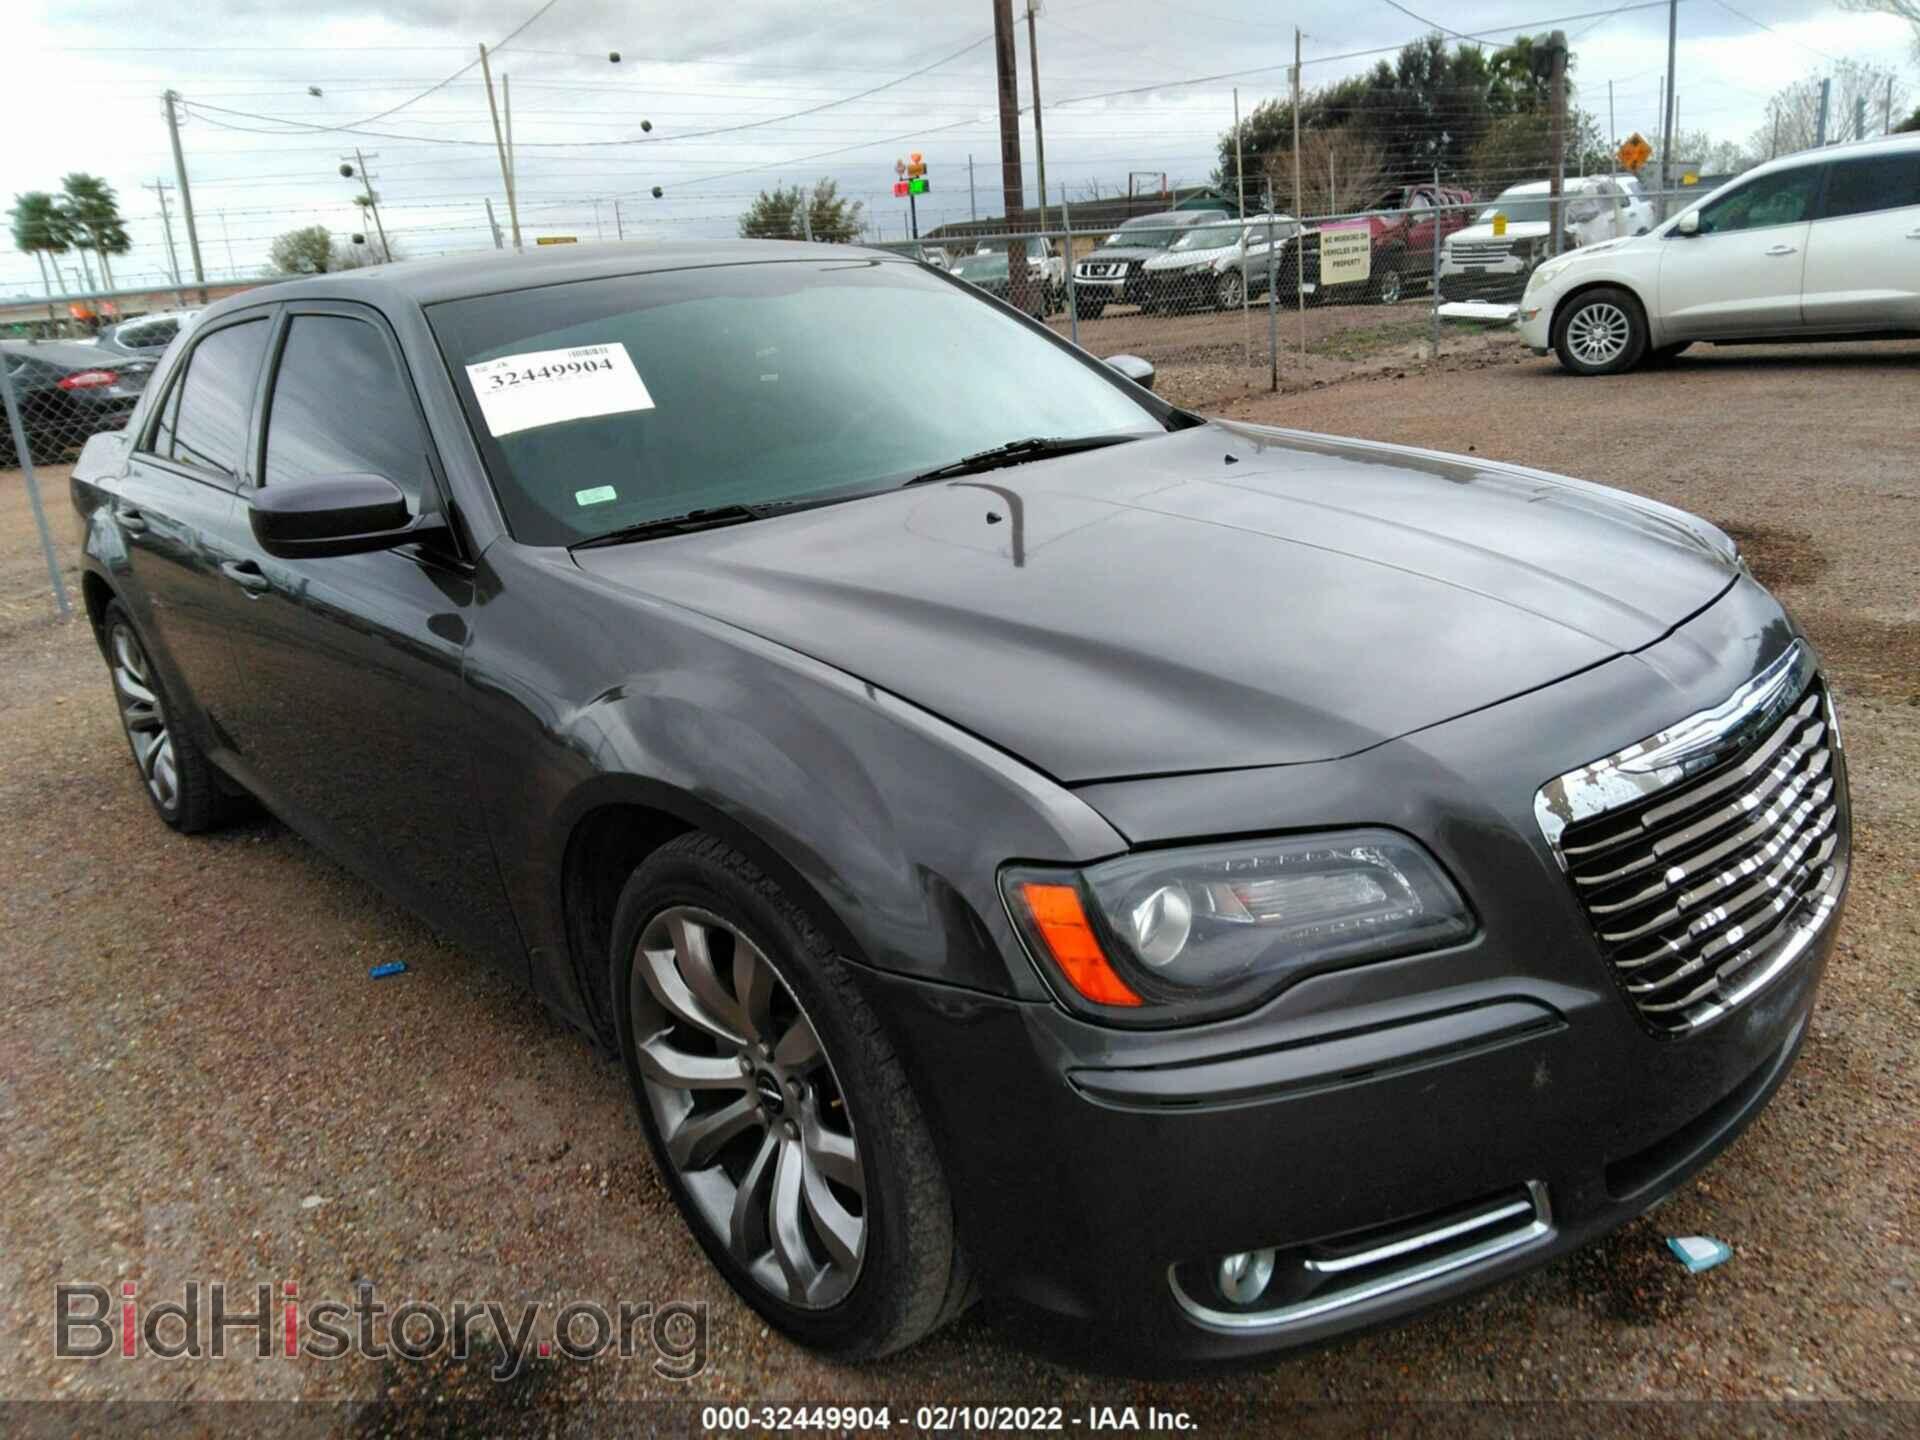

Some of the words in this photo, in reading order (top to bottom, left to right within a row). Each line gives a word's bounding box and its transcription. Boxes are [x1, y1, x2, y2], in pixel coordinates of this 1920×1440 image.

[1323, 247, 1349, 256] VEHICLES
[1333, 258, 1360, 267] PROPERTY
[489, 358, 613, 389] 32449904
